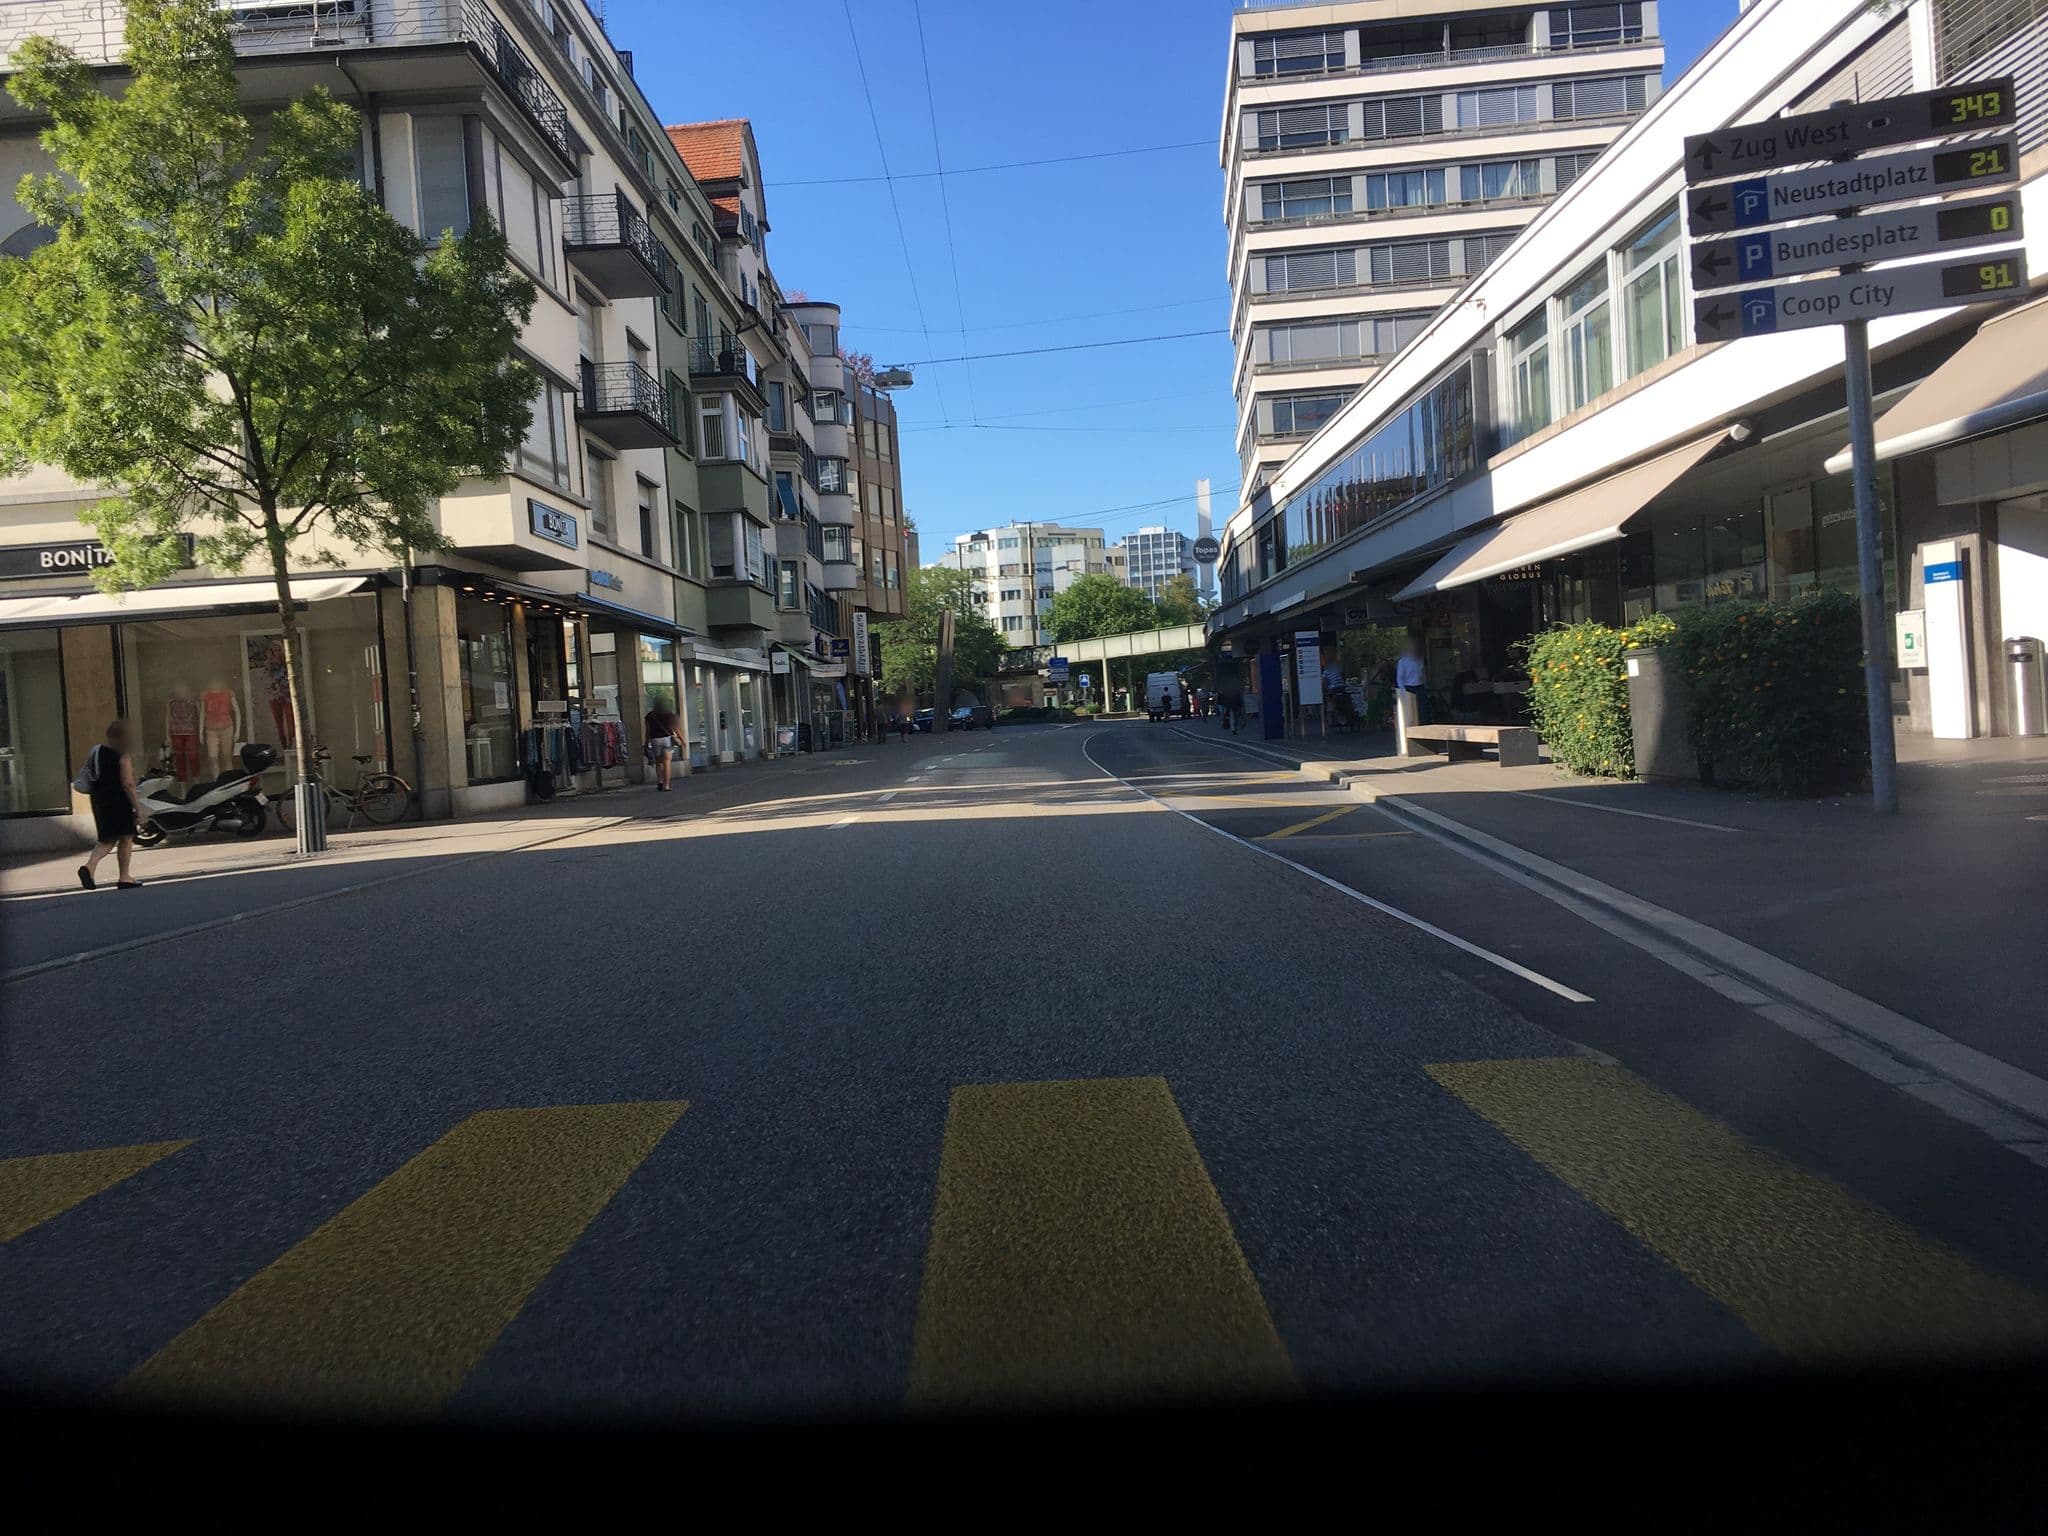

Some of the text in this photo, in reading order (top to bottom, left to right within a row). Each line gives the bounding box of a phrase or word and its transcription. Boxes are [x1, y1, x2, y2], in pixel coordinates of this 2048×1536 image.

[1730, 92, 2001, 161] Zug West 343
[1744, 151, 2004, 215] P Neustadtplatz 21
[1745, 206, 2009, 270] P Bundesplatz 0
[1751, 263, 2014, 324] P Coop City 91
[1500, 572, 1541, 581] GLOBUS
